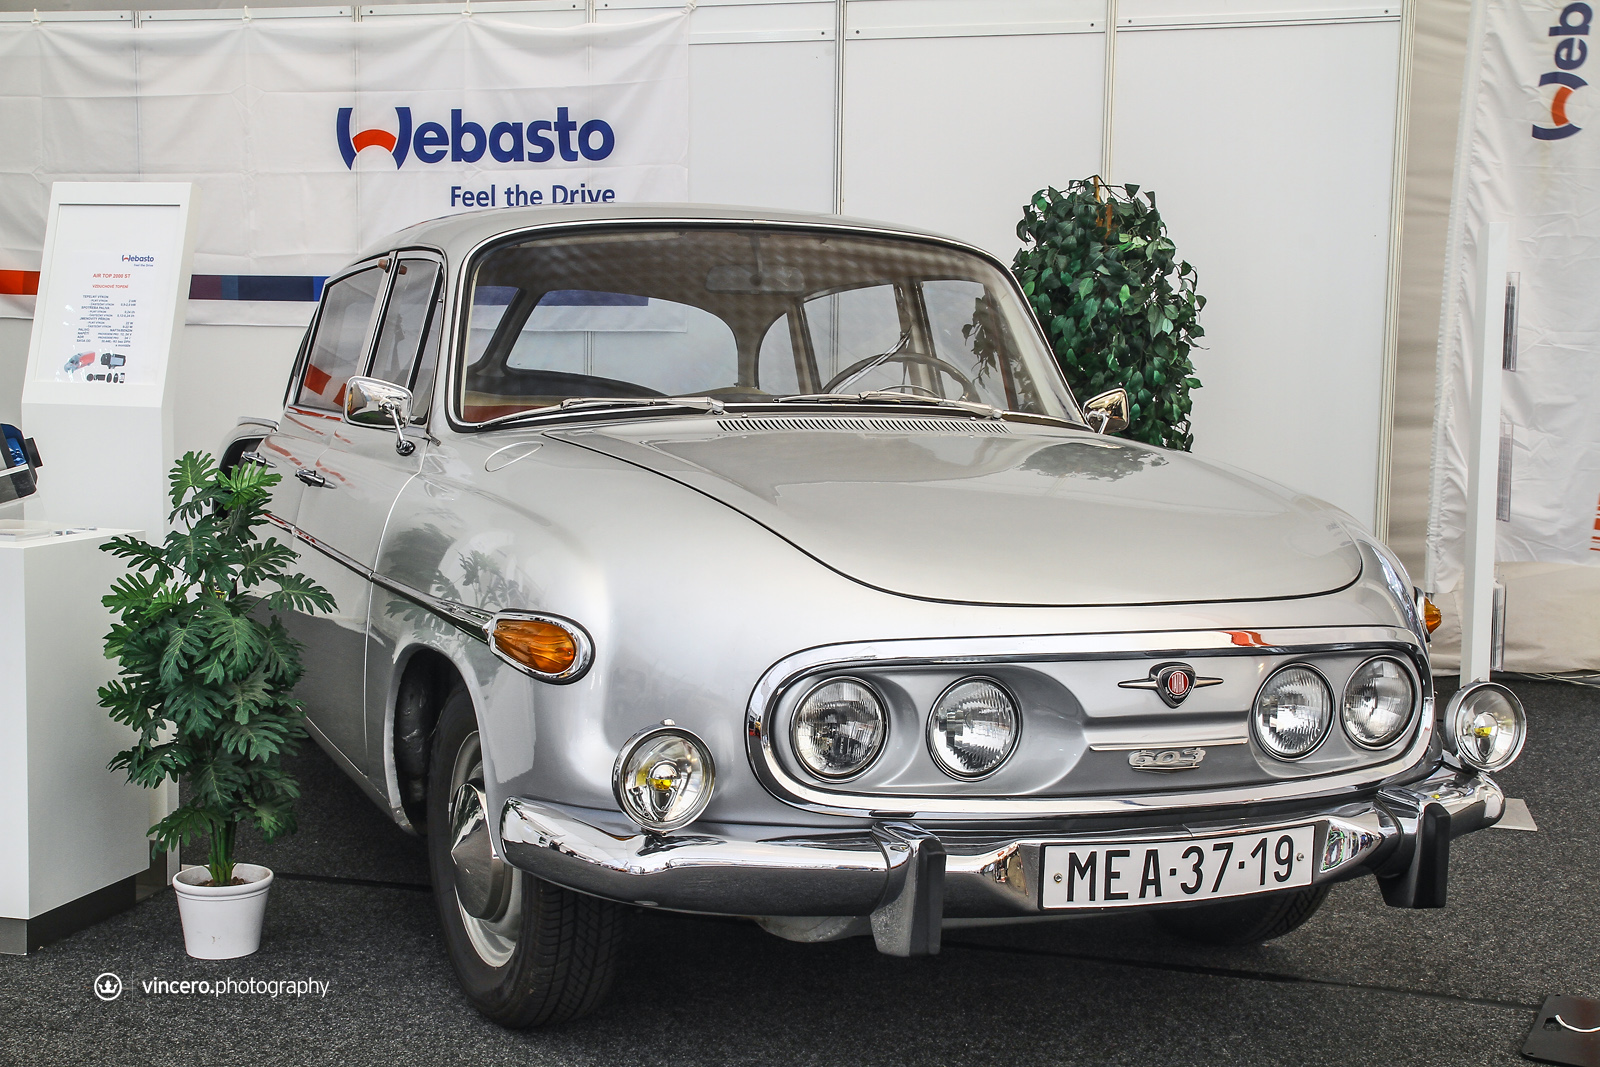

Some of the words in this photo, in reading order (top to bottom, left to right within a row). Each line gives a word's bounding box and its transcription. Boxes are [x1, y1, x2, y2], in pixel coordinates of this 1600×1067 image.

[336, 106, 615, 171] Webasto
[451, 184, 496, 207] Feel
[504, 184, 543, 206] the
[552, 183, 615, 205] Drive
